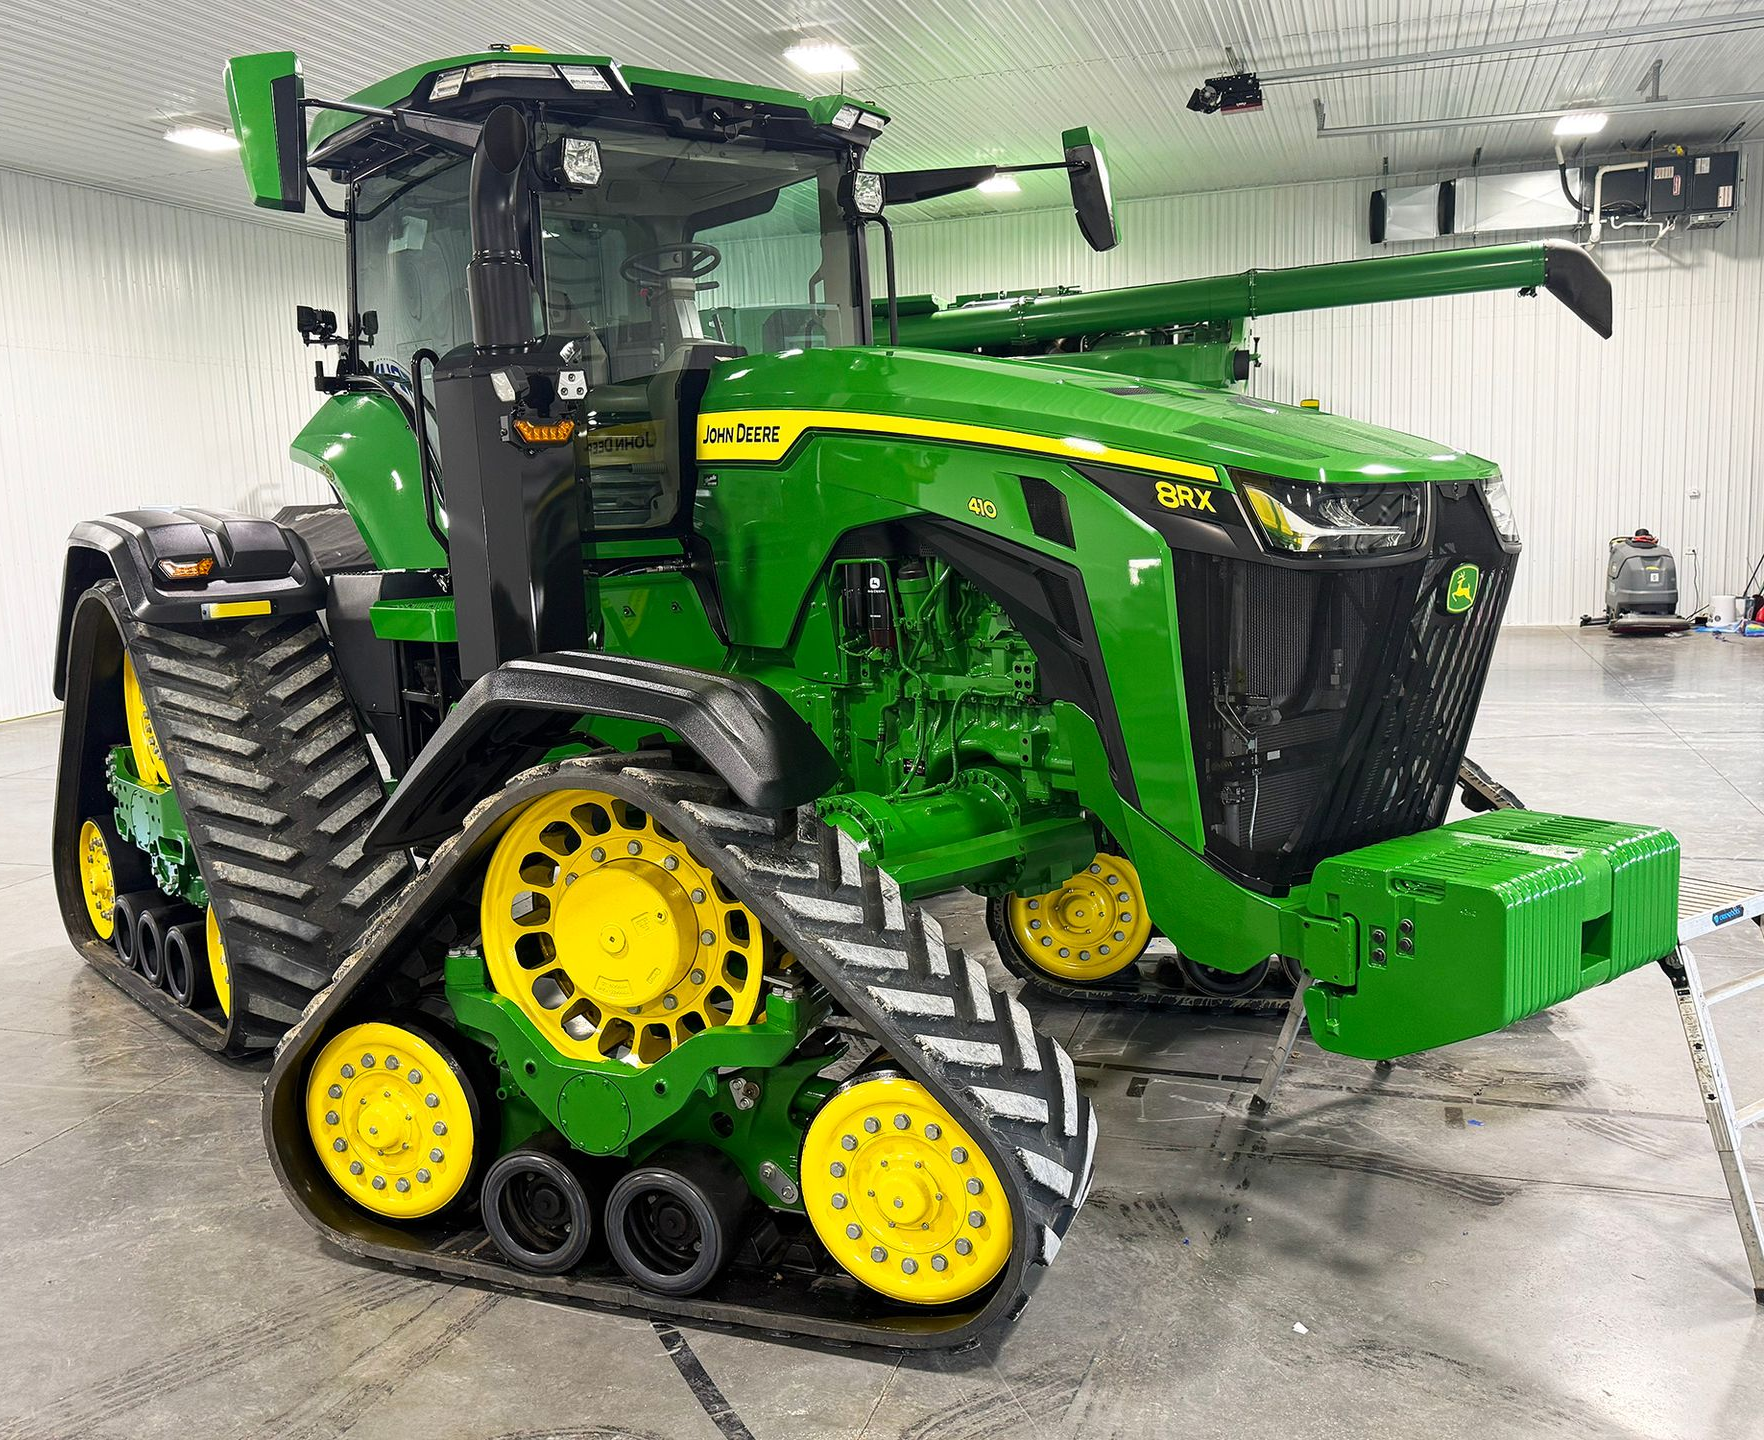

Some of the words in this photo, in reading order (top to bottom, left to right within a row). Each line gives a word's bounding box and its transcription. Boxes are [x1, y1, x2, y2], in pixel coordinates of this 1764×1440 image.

[703, 425, 733, 444] JOHN
[736, 423, 780, 443] DEERE
[968, 497, 997, 519] 410
[1155, 481, 1217, 513] 8RX
